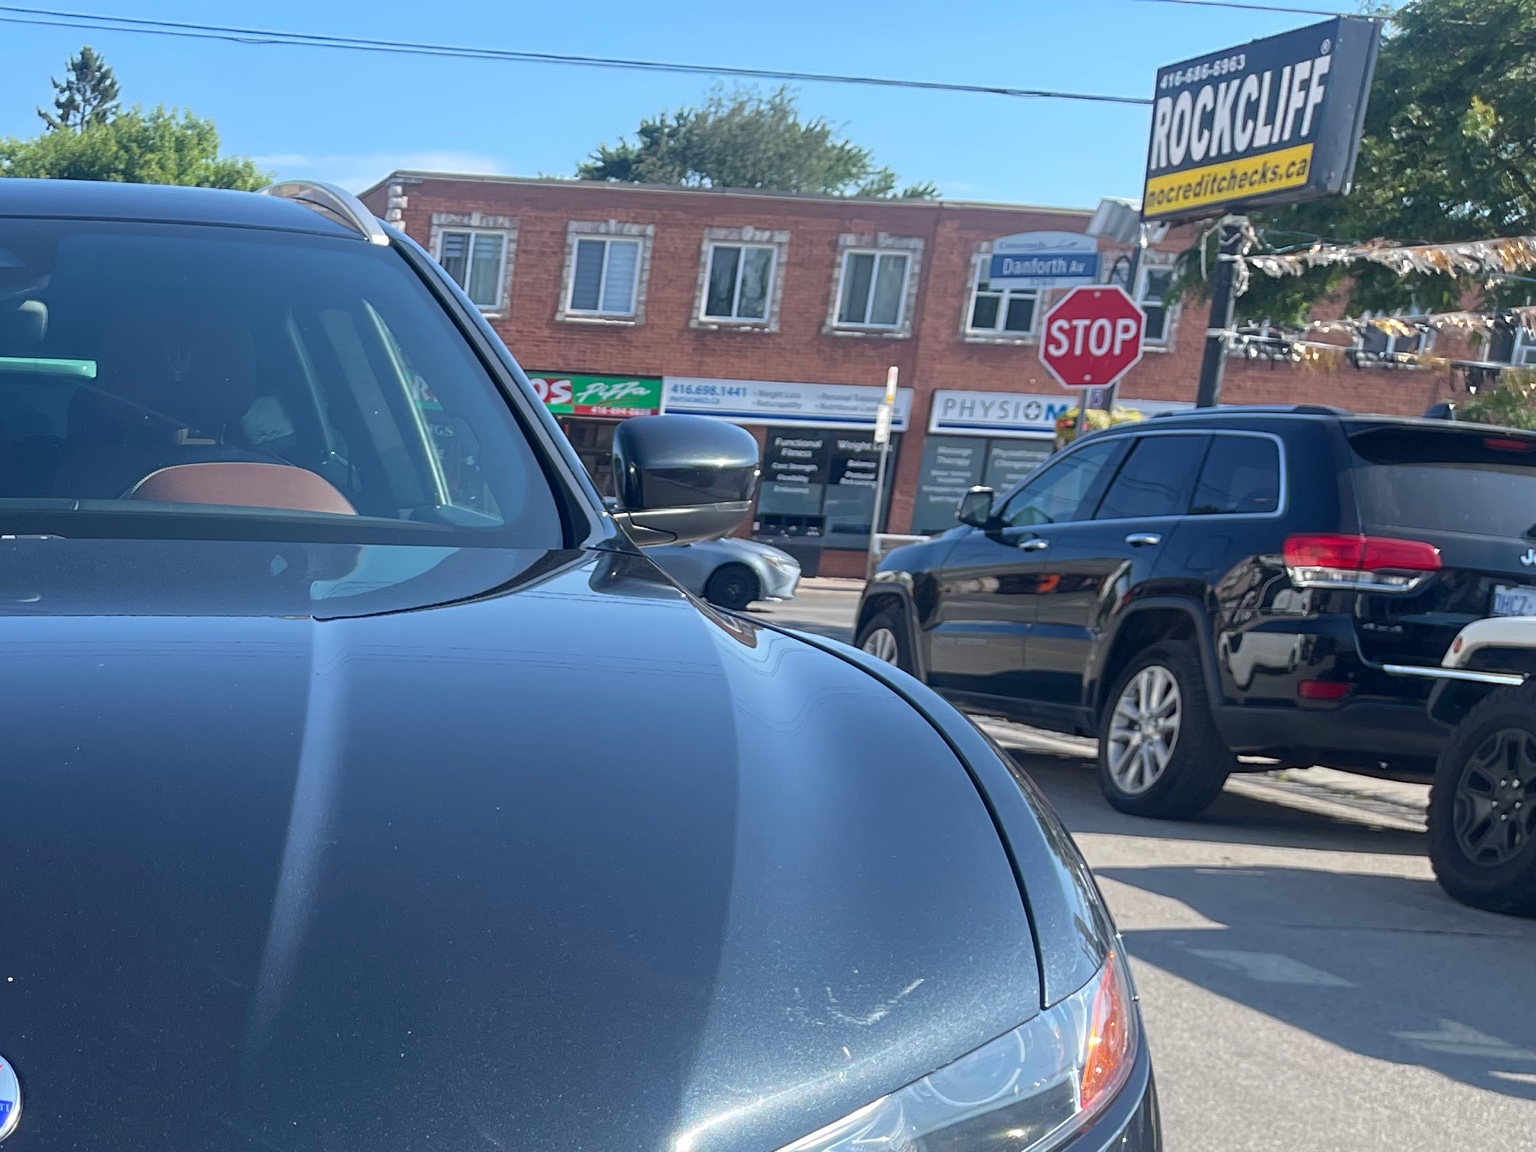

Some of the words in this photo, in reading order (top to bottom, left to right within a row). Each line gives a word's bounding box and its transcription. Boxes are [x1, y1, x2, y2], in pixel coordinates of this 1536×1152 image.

[1150, 54, 1332, 171] ROCKCLIFF
[1145, 157, 1308, 208] nocreditchecks.ca
[1002, 257, 1067, 275] Danforth
[1069, 260, 1087, 274] Av
[1047, 318, 1138, 358] STOP
[575, 381, 653, 403] Pizza
[671, 384, 747, 398] 416.698.1441
